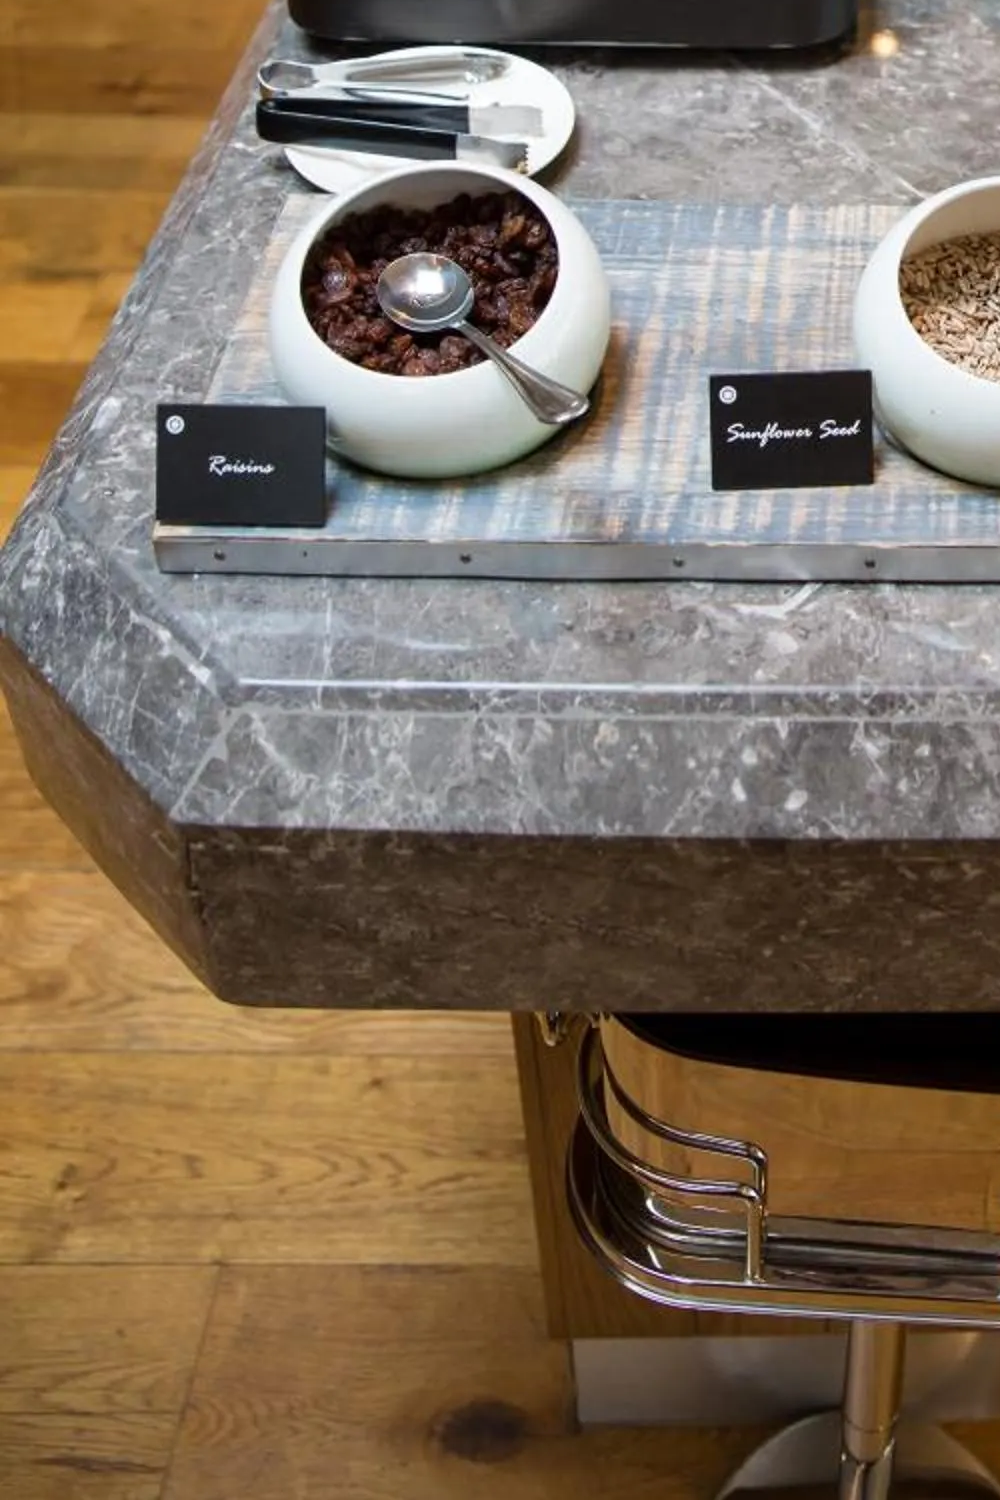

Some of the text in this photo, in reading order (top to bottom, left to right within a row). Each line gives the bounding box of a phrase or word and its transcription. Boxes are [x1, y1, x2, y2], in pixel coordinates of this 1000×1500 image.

[726, 418, 862, 448] Sunflower Seed
[208, 454, 275, 476] Raisins
